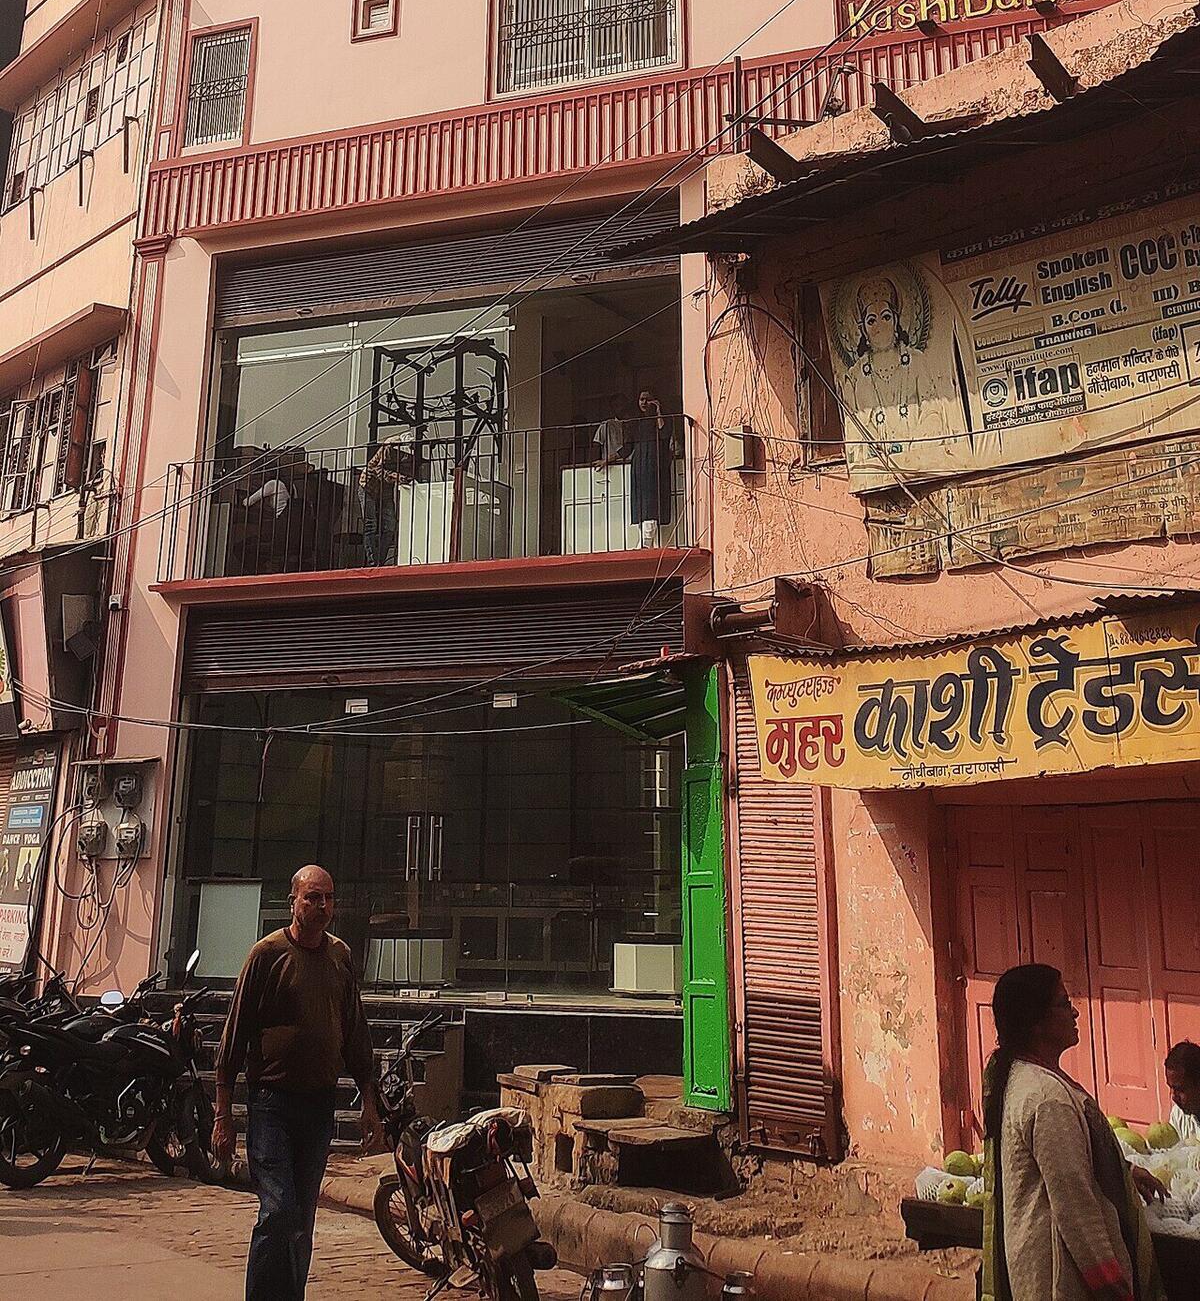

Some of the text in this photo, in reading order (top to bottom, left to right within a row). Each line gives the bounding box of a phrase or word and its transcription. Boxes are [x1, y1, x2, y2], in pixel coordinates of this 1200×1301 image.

[1036, 247, 1110, 280] Spoken
[1119, 234, 1178, 280] CCC
[968, 275, 1033, 322] Tally
[1041, 272, 1113, 305] English
[1051, 307, 1106, 328] B.Com
[1038, 327, 1092, 347] TRAINING
[1151, 324, 1179, 345] (ifap)
[1155, 348, 1165, 362] के
[1165, 344, 1180, 360] पीछे
[1012, 361, 1081, 402] ifap
[1136, 359, 1181, 386] वाराणसी
[854, 646, 1021, 758] काशी
[765, 713, 846, 778] मुहर
